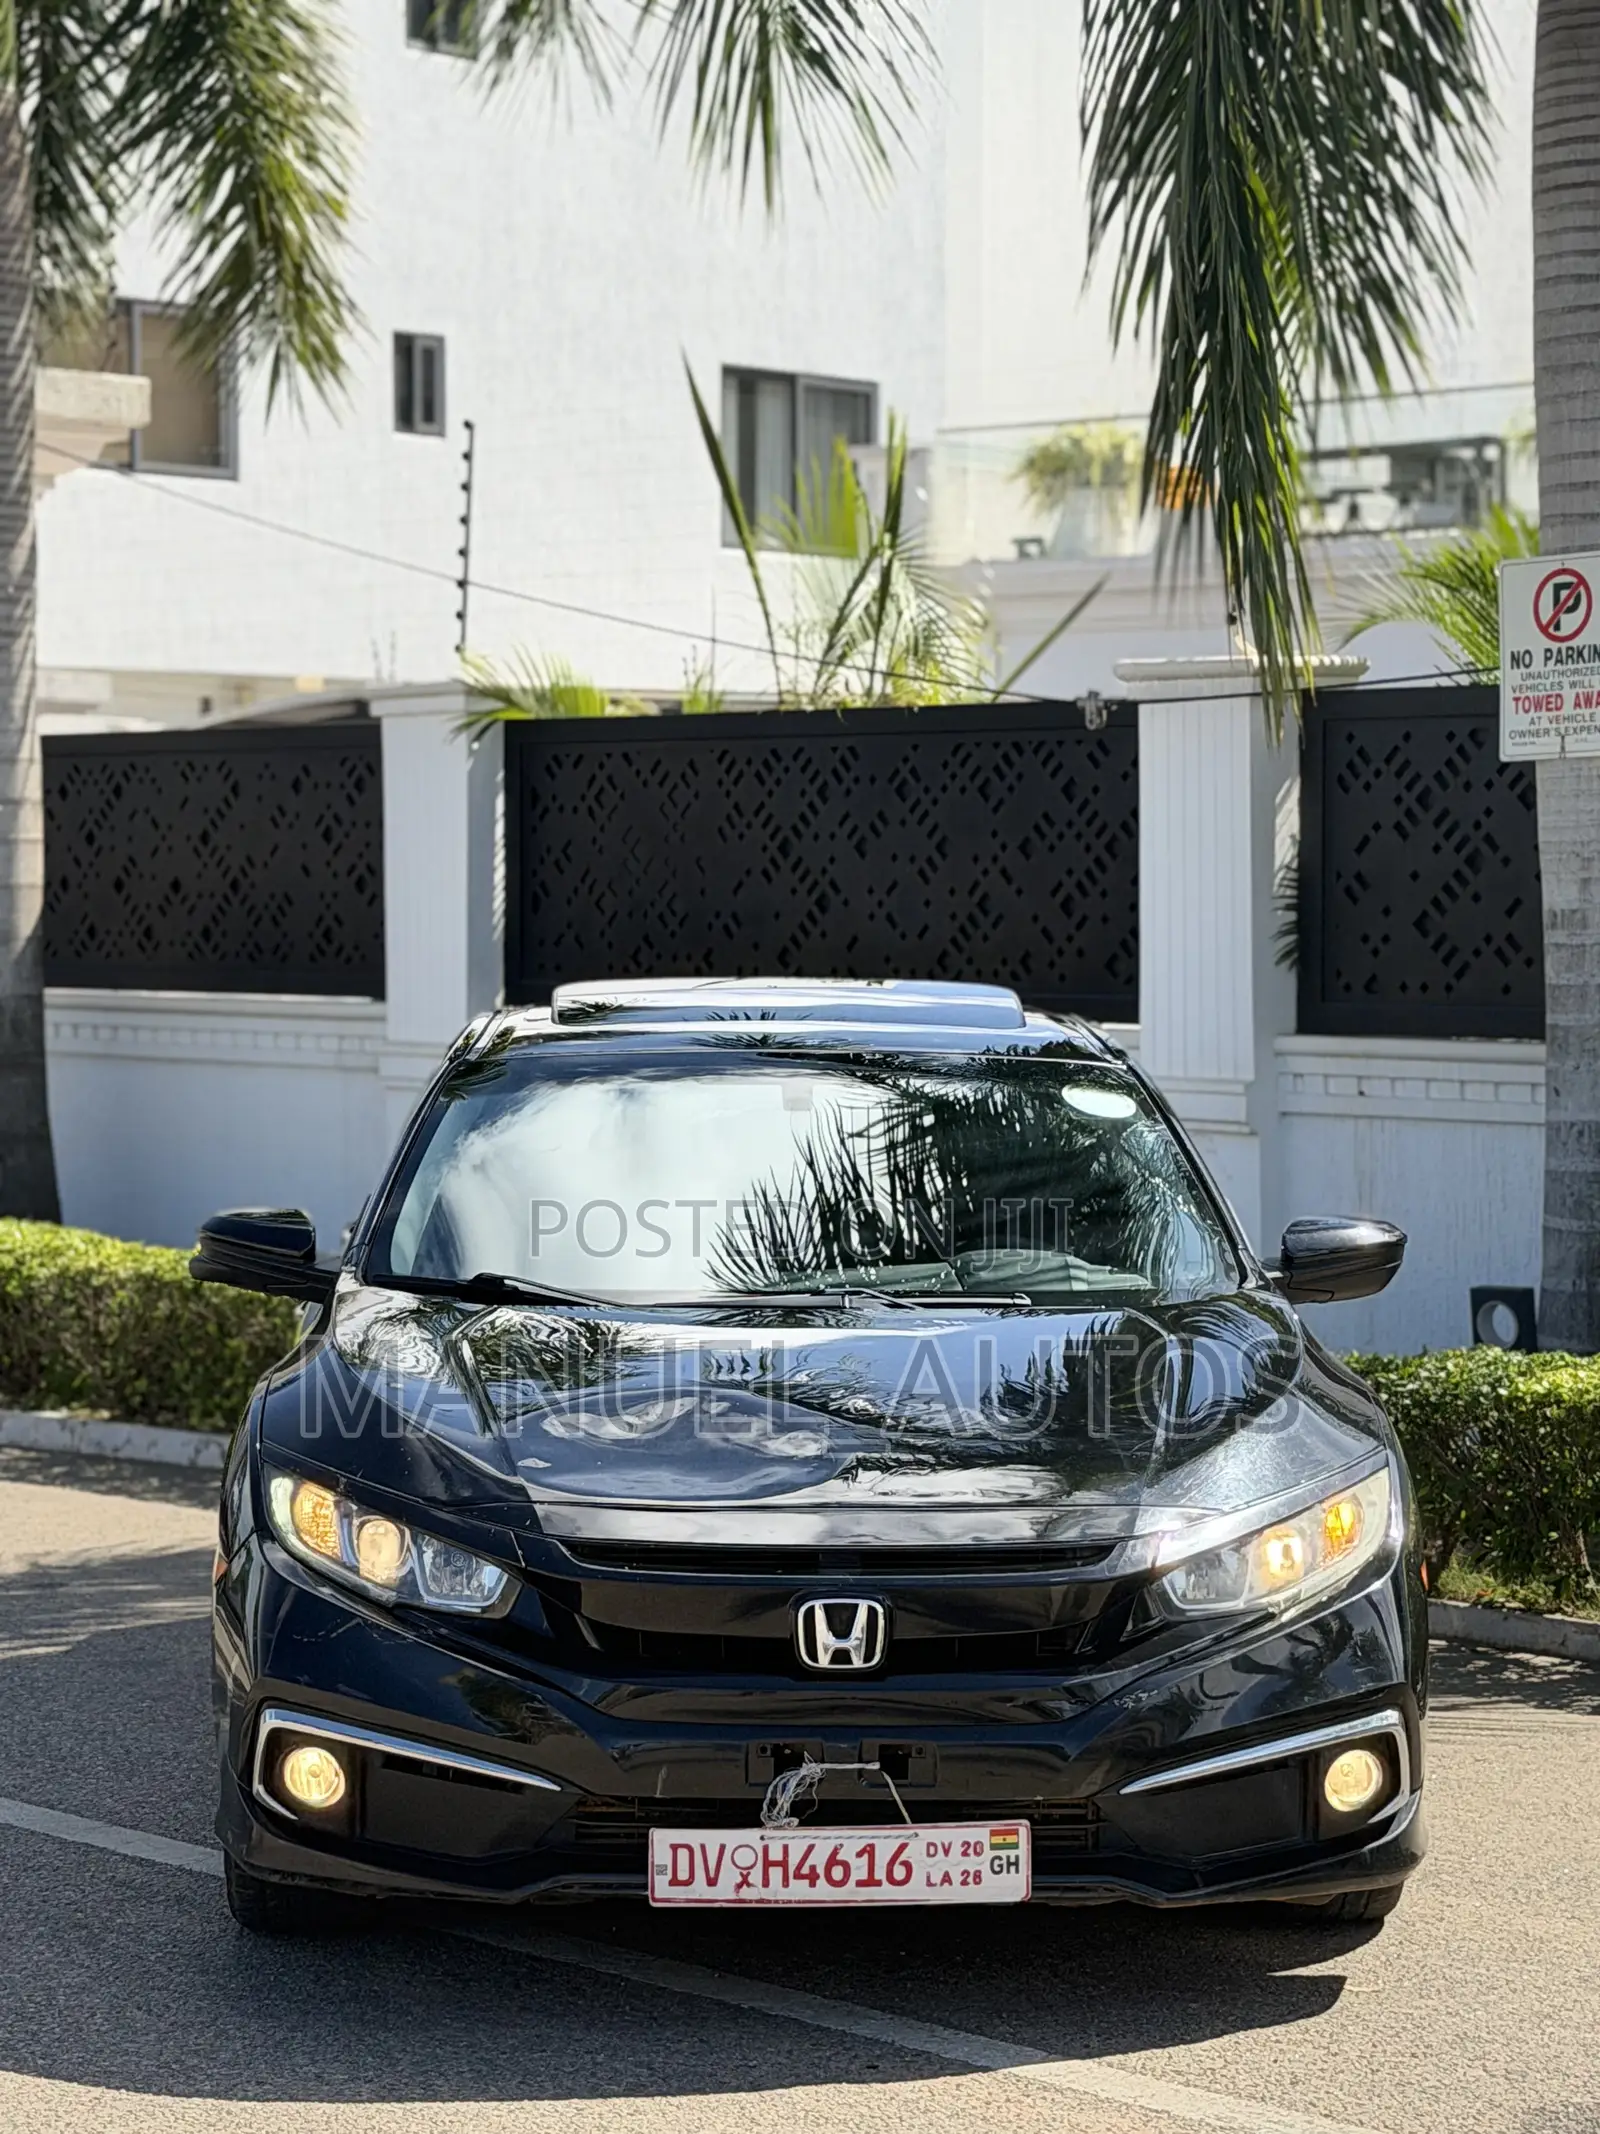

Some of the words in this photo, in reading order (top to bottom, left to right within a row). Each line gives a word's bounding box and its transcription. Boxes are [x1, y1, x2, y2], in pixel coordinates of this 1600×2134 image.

[1510, 649, 1533, 670] NO
[1511, 681, 1564, 694] VEHICLES
[1568, 679, 1594, 690] WILL
[1512, 693, 1564, 715] TOWED
[1528, 716, 1542, 727] AT
[1547, 712, 1597, 725] VEHICLE
[925, 1841, 953, 1858] DV
[668, 1843, 727, 1888] DV
[761, 1842, 914, 1889] H4616
[989, 1854, 1020, 1875] GH
[925, 1870, 953, 1888] LA
